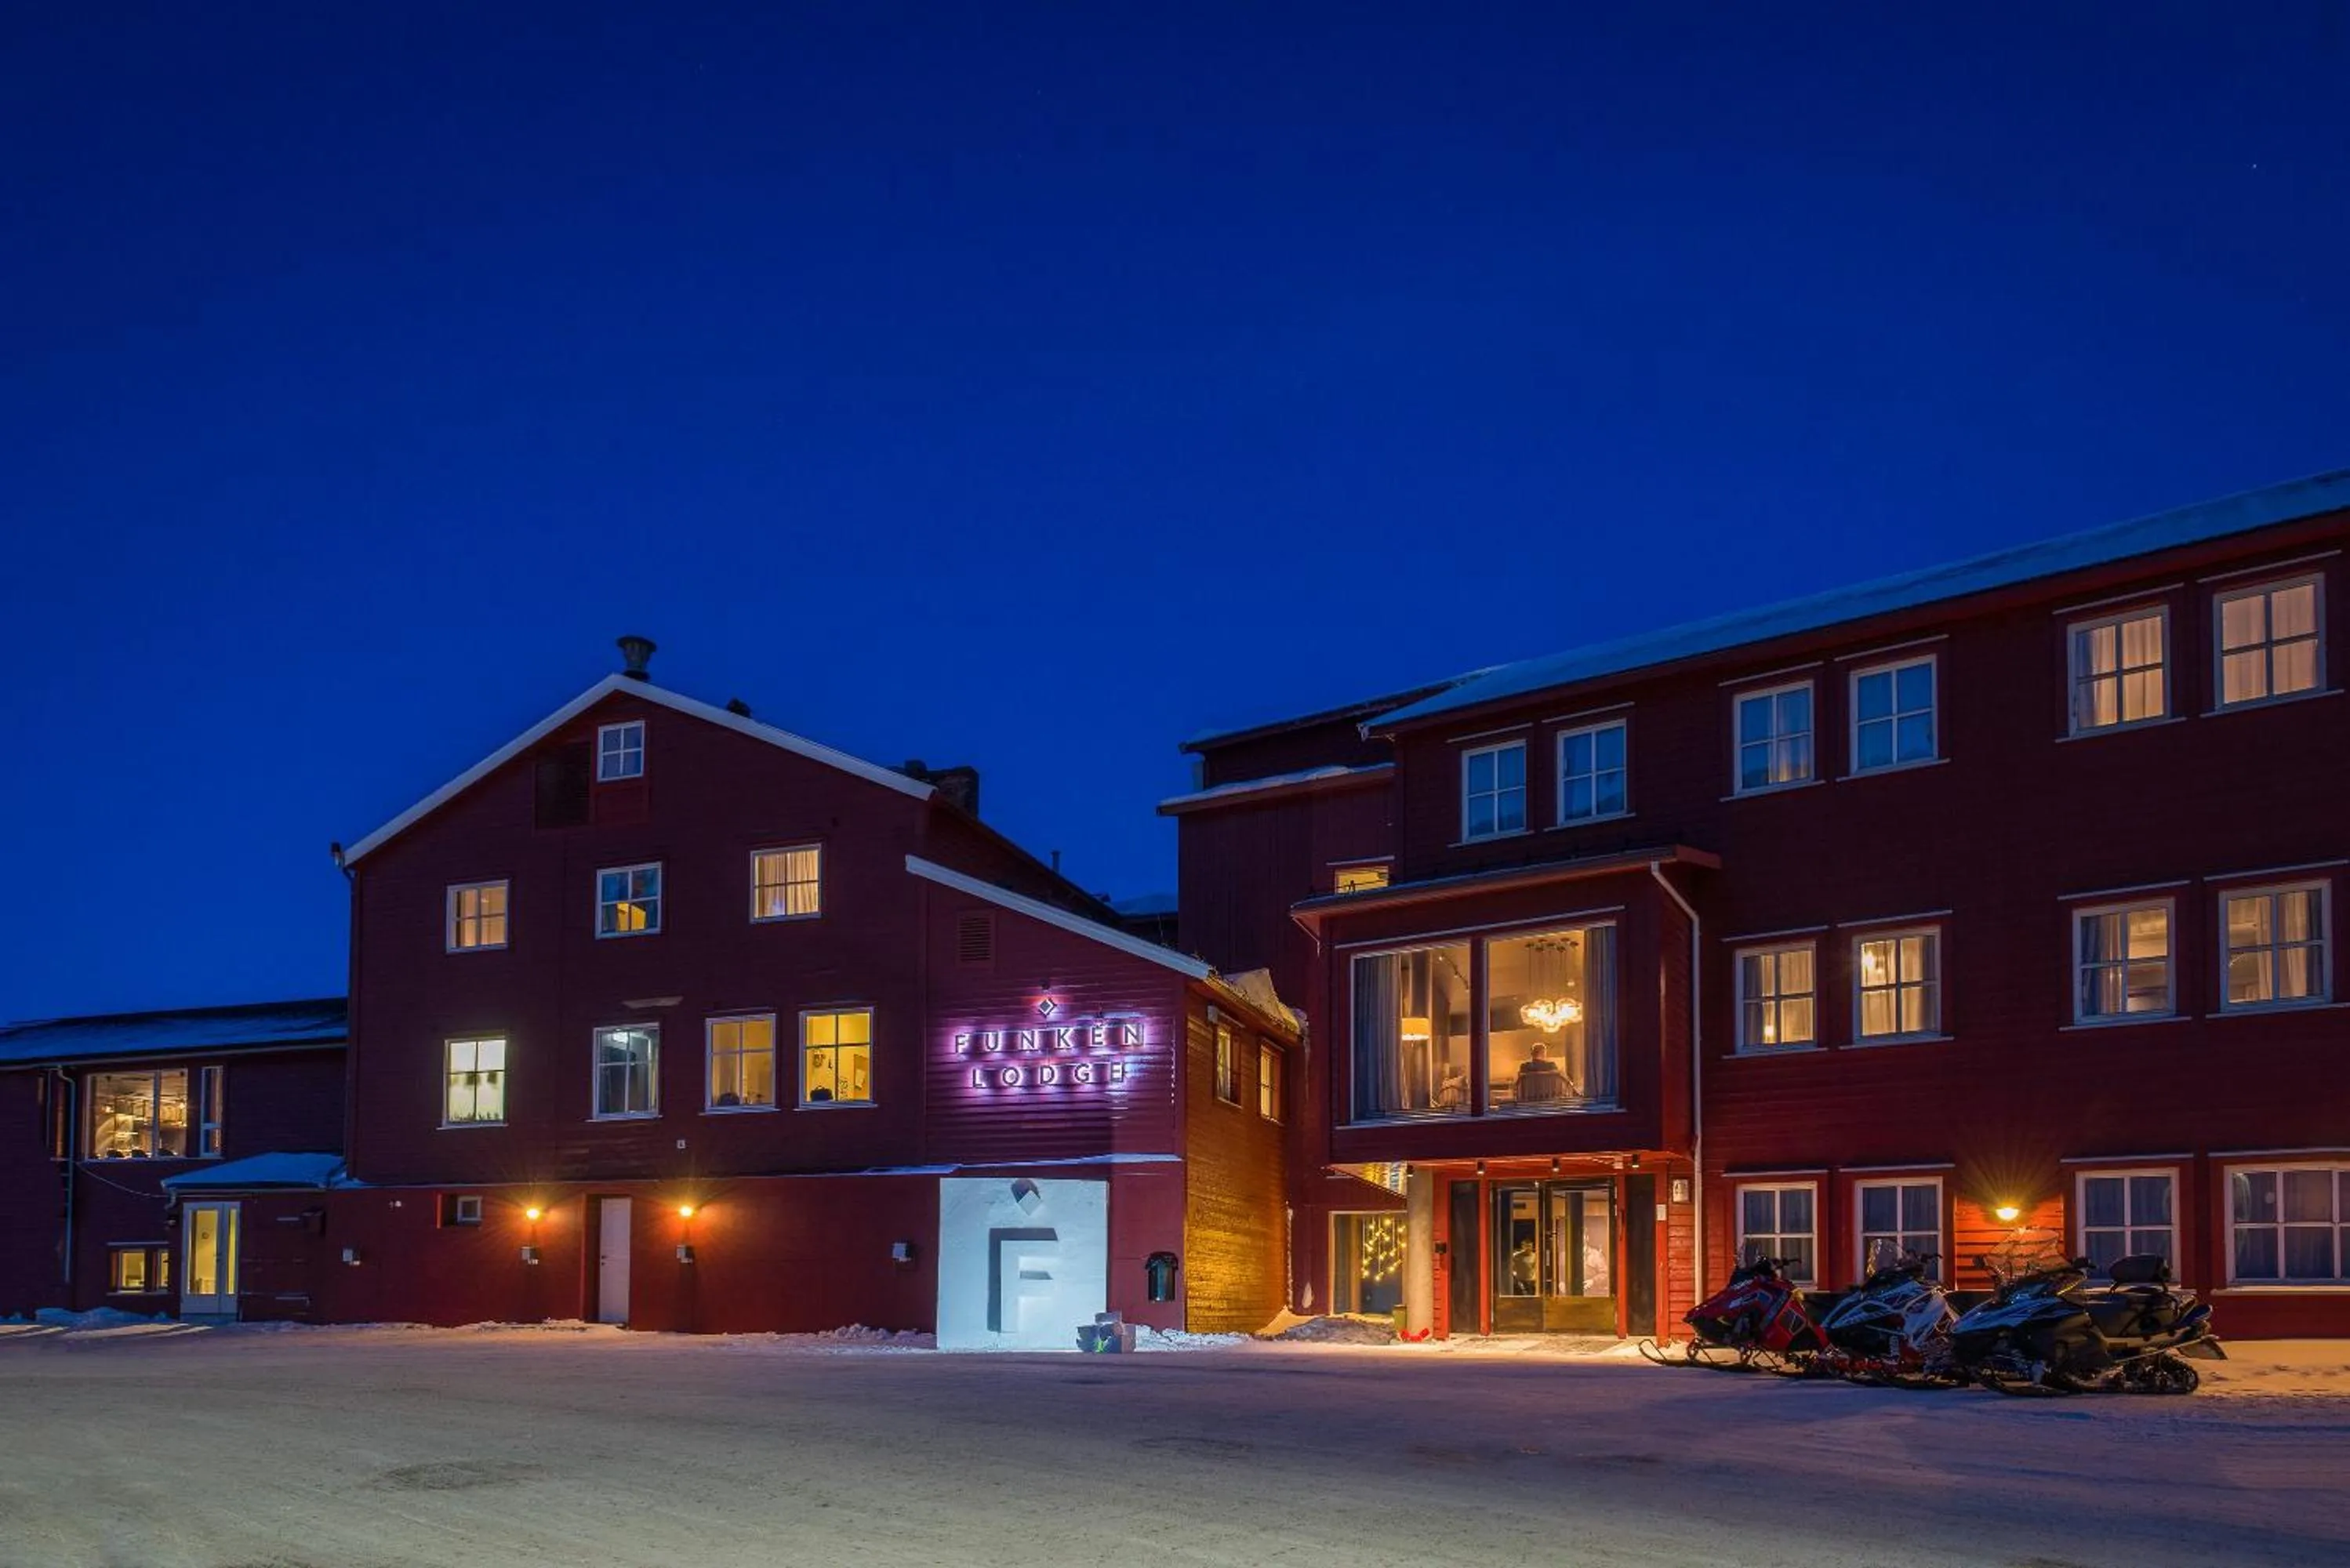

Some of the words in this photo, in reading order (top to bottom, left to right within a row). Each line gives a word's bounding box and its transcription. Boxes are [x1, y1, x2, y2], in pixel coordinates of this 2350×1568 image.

[955, 1024, 1145, 1053] FUNKEN
[972, 1062, 1125, 1087] LODGE
[988, 1228, 1059, 1333] F
